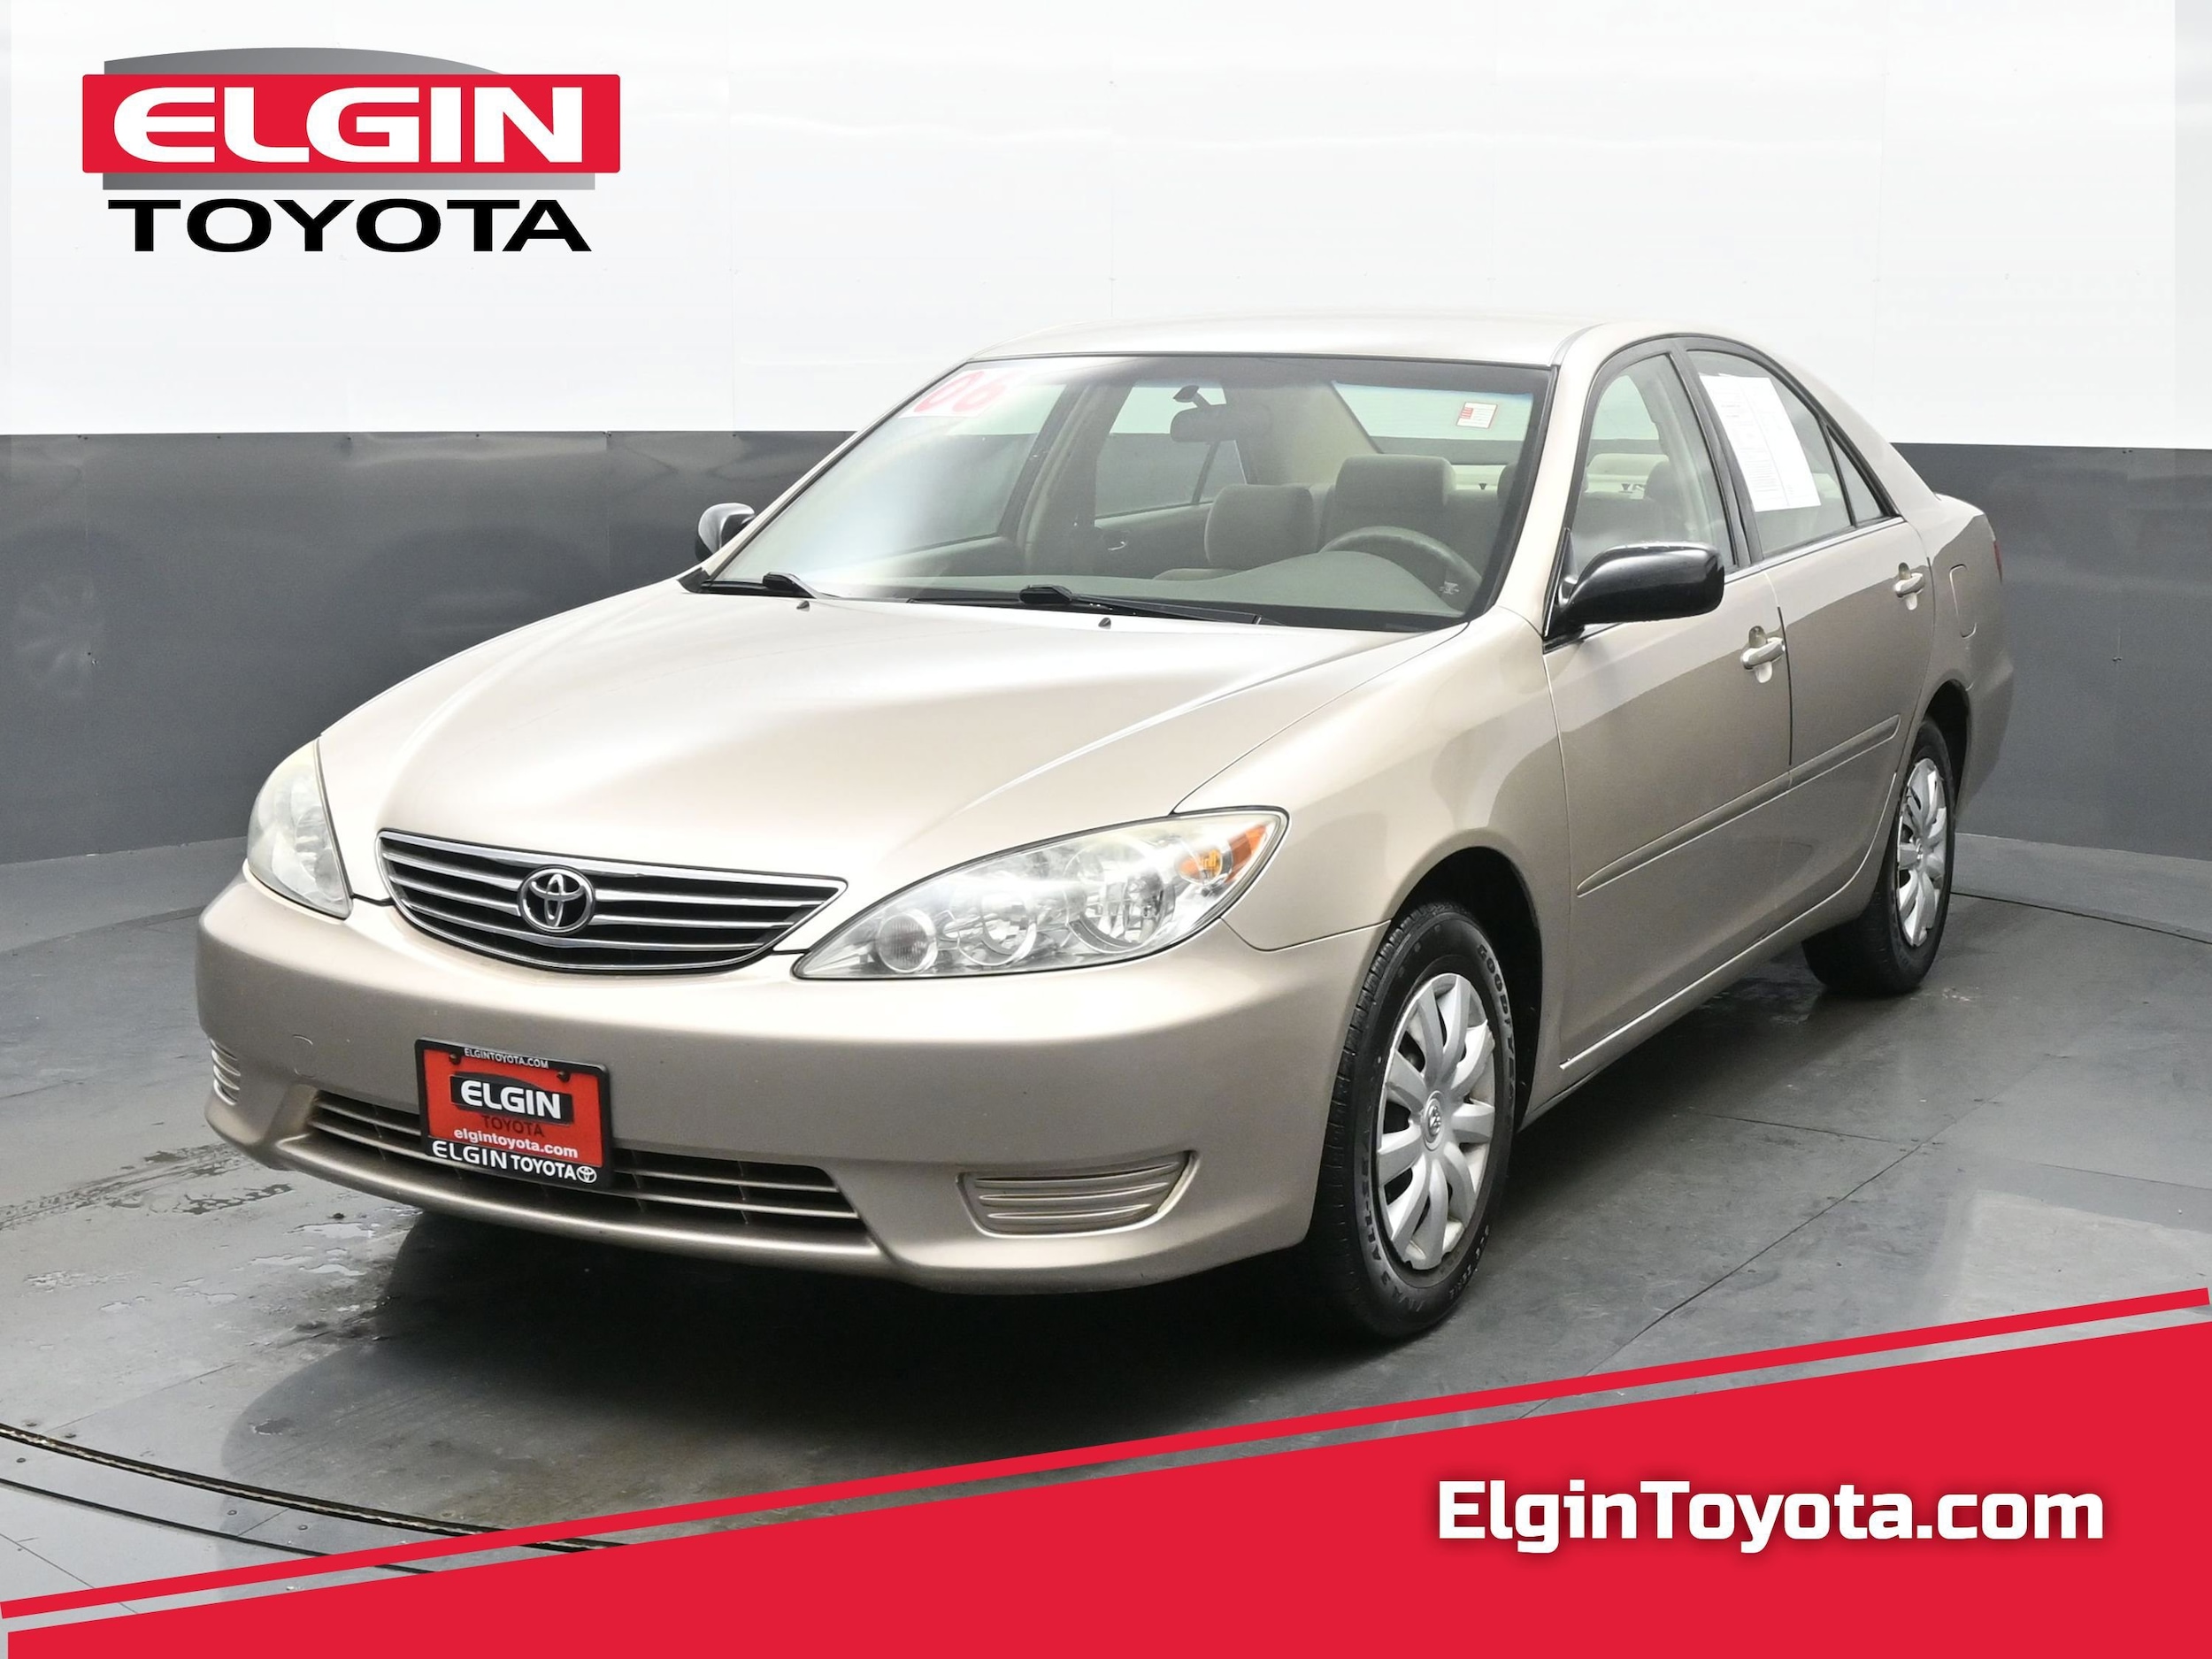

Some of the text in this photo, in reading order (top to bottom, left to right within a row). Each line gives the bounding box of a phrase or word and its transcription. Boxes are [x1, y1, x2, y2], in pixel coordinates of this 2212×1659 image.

[913, 370, 1025, 413] 06
[464, 1048, 549, 1070] ELGINTOYOTA.COM
[460, 1079, 562, 1119] ELGIN
[453, 1128, 579, 1159] elgintoyota.com
[481, 1115, 546, 1138] TOYOTA
[432, 1141, 577, 1181] ELGIN TOYOTA
